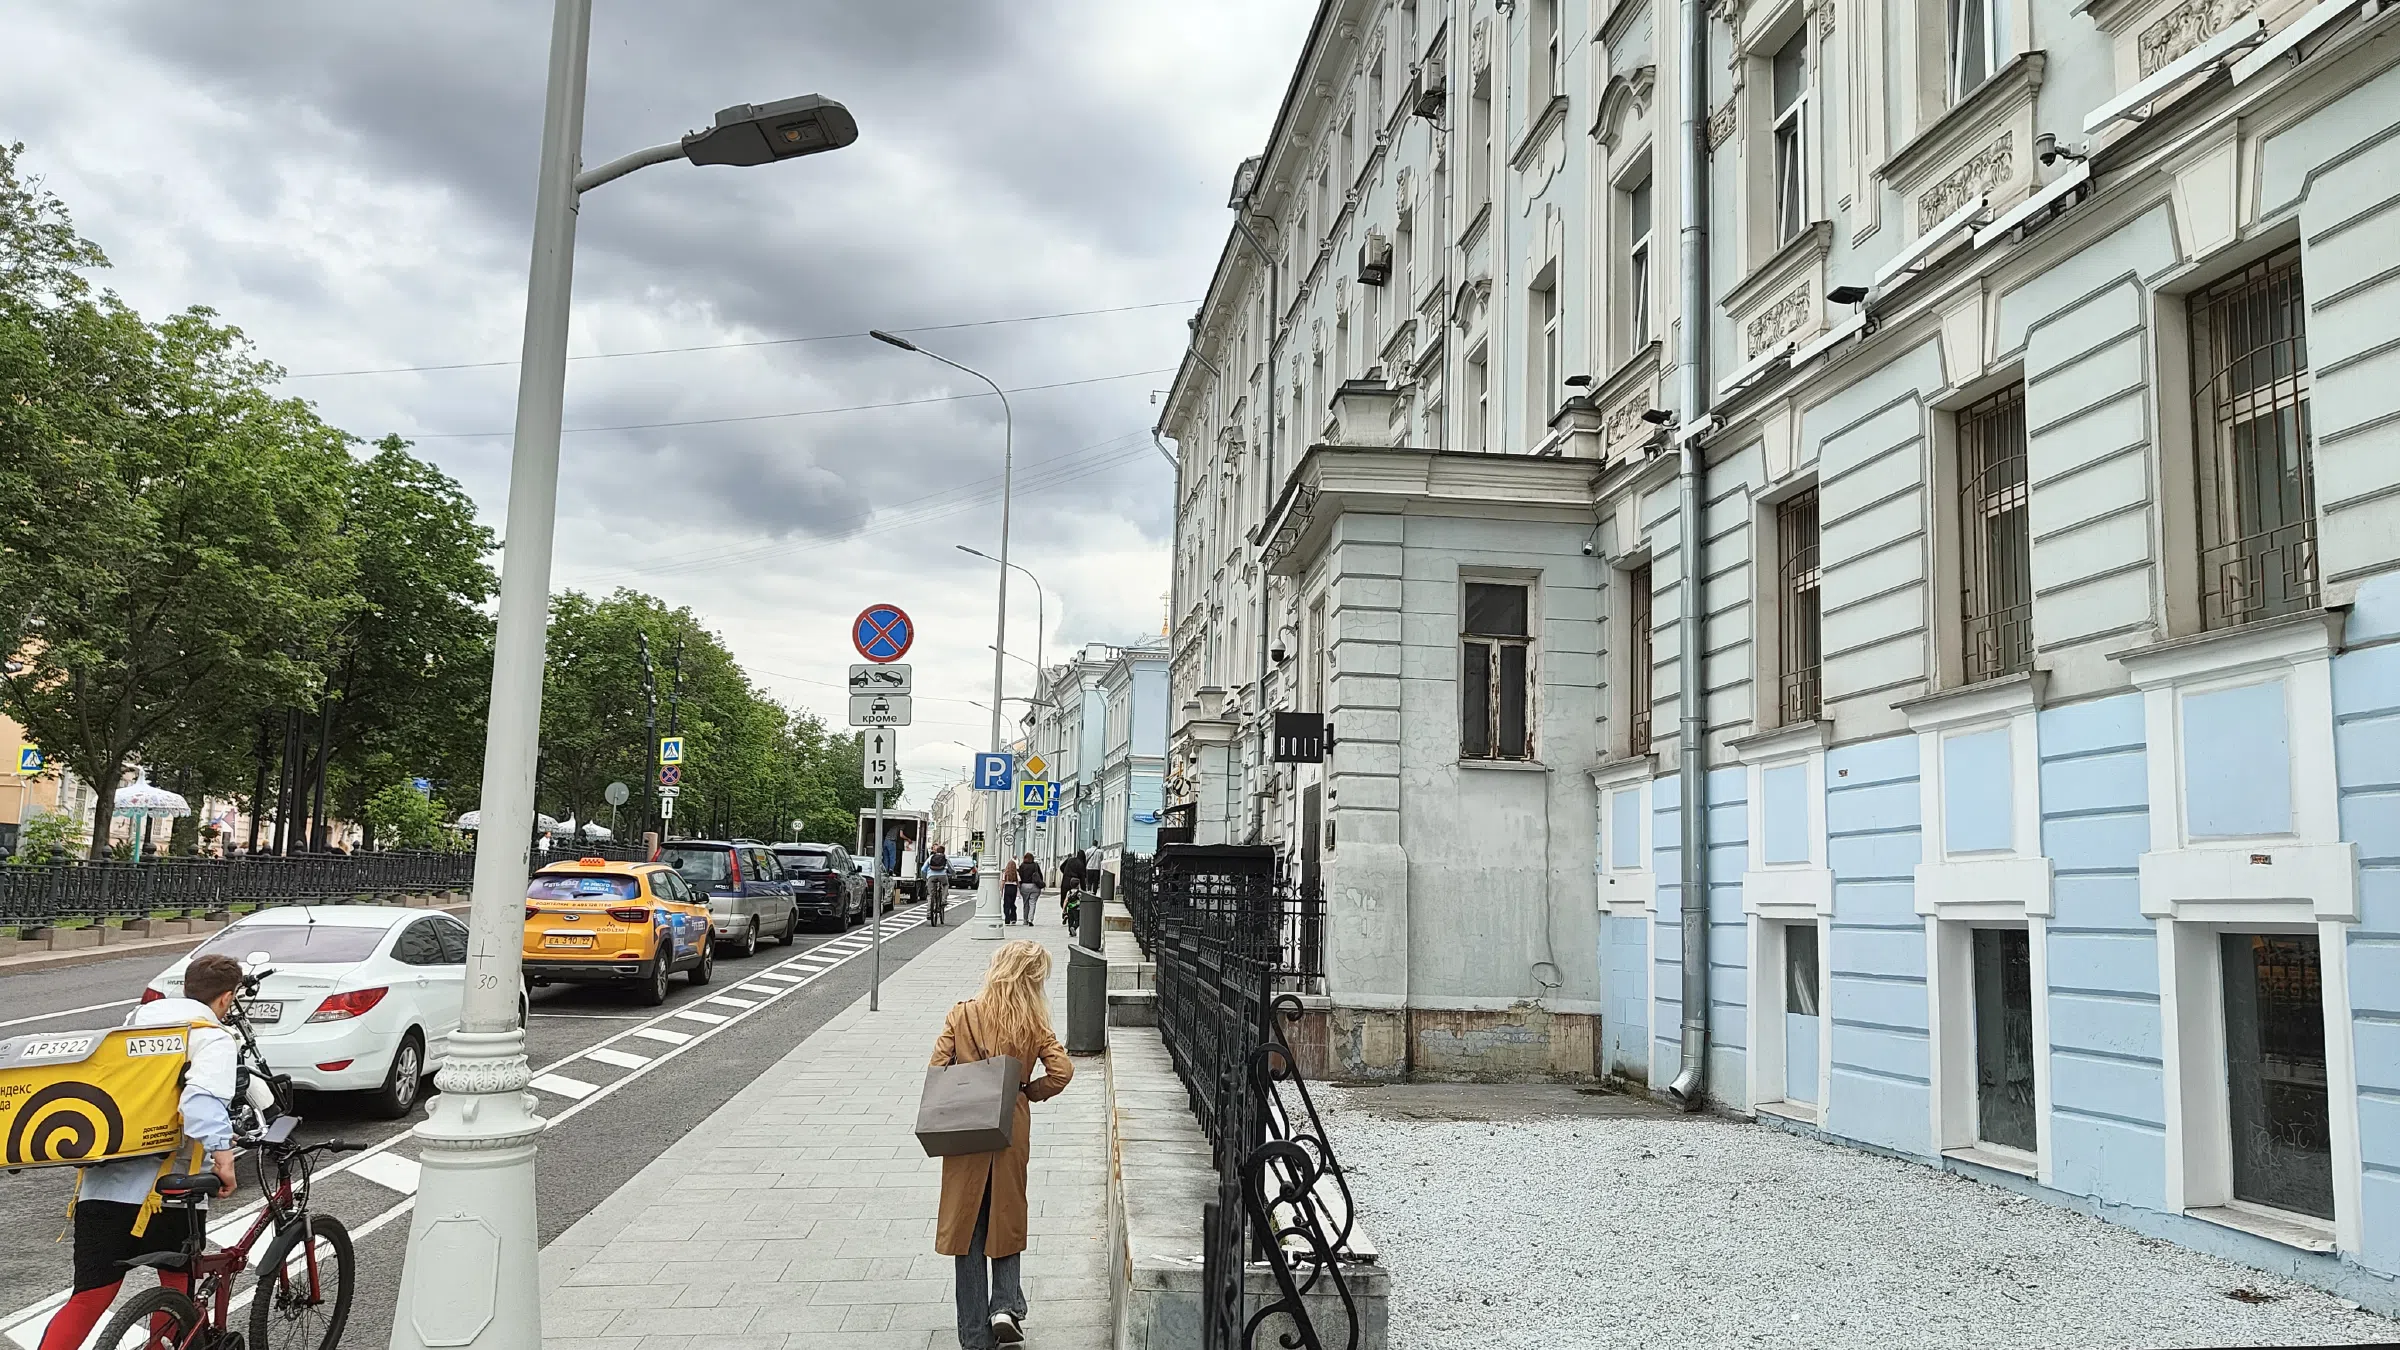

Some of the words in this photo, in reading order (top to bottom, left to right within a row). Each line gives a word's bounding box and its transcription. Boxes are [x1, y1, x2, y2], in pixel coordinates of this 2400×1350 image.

[862, 714, 898, 725] кроме
[1279, 736, 1319, 758] BOLT
[871, 759, 887, 772] 15
[984, 757, 1006, 787] P
[478, 974, 498, 990] 30
[258, 1003, 278, 1013] 126
